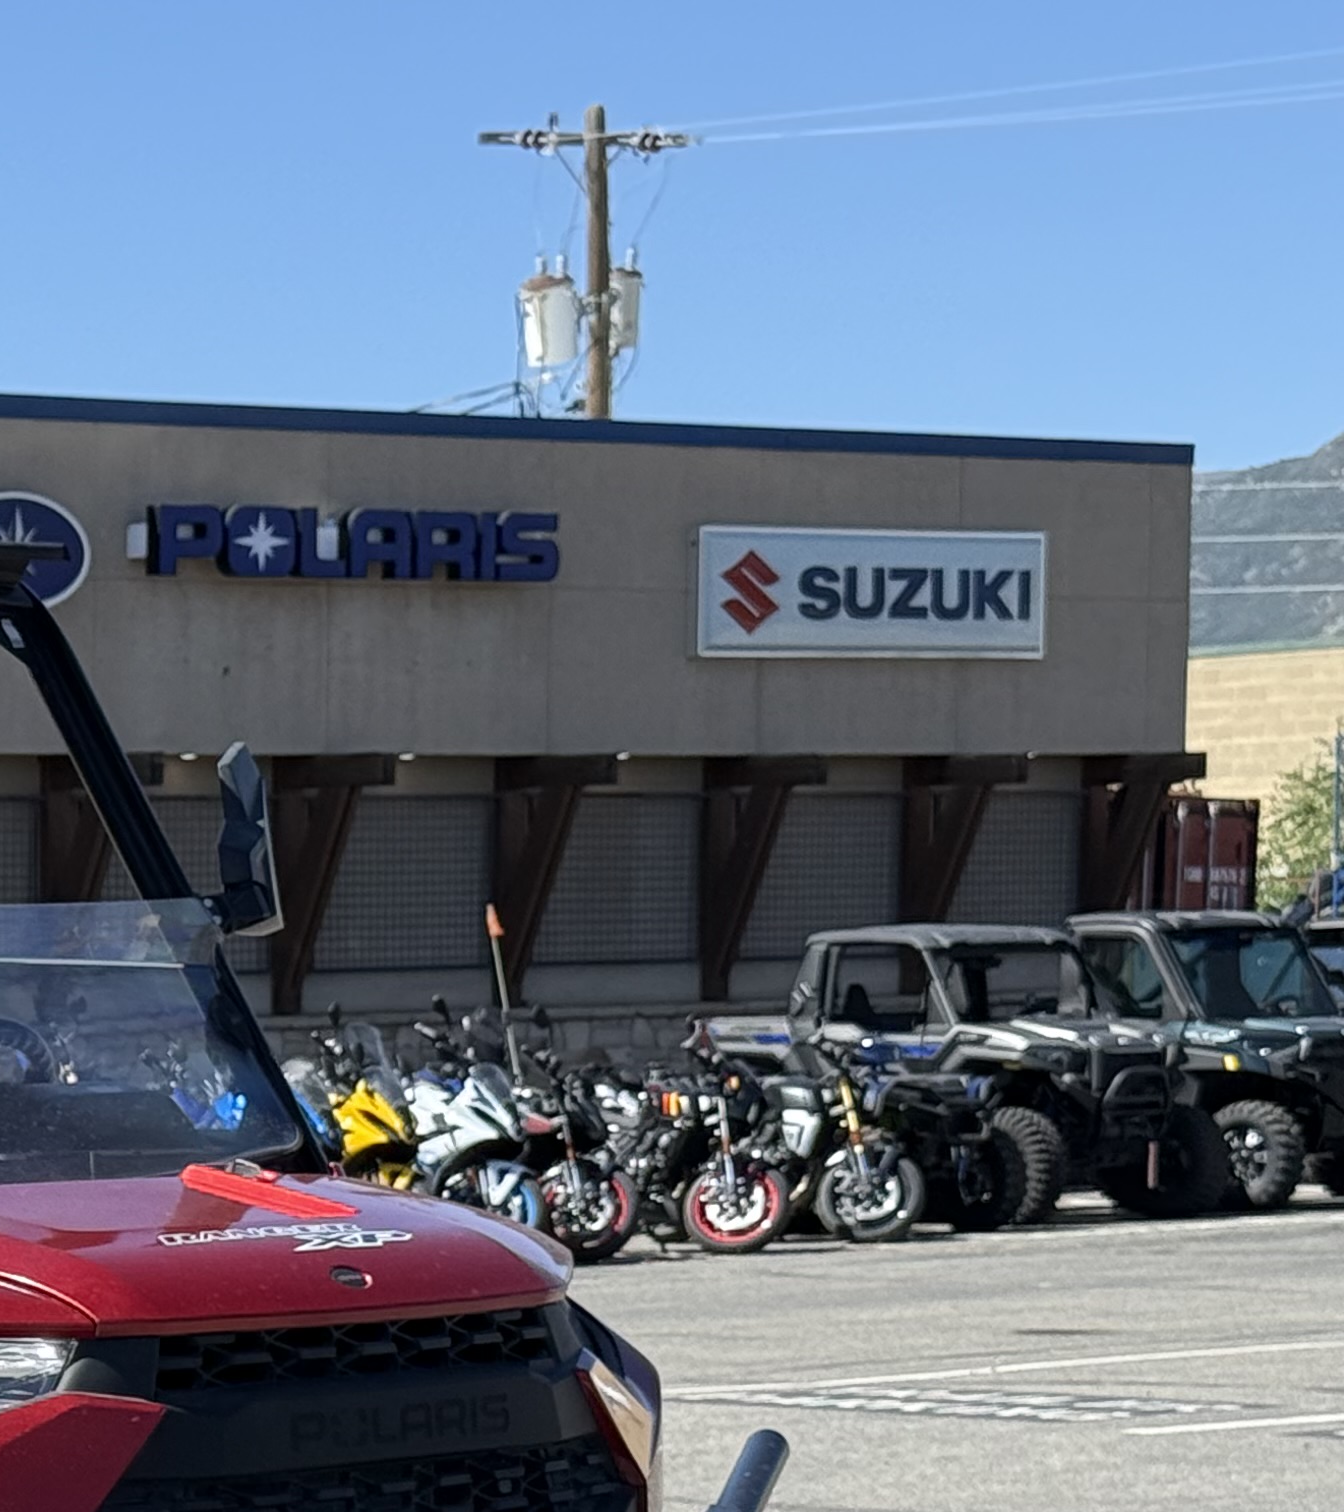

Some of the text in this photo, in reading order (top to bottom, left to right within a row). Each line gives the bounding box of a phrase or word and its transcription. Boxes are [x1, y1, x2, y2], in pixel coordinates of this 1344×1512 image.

[154, 504, 560, 582] POLARIS
[797, 565, 1032, 621] SUZUKI
[157, 1223, 361, 1246] RANGER
[293, 1229, 413, 1252] XP
[289, 1391, 512, 1453] POLARIS
